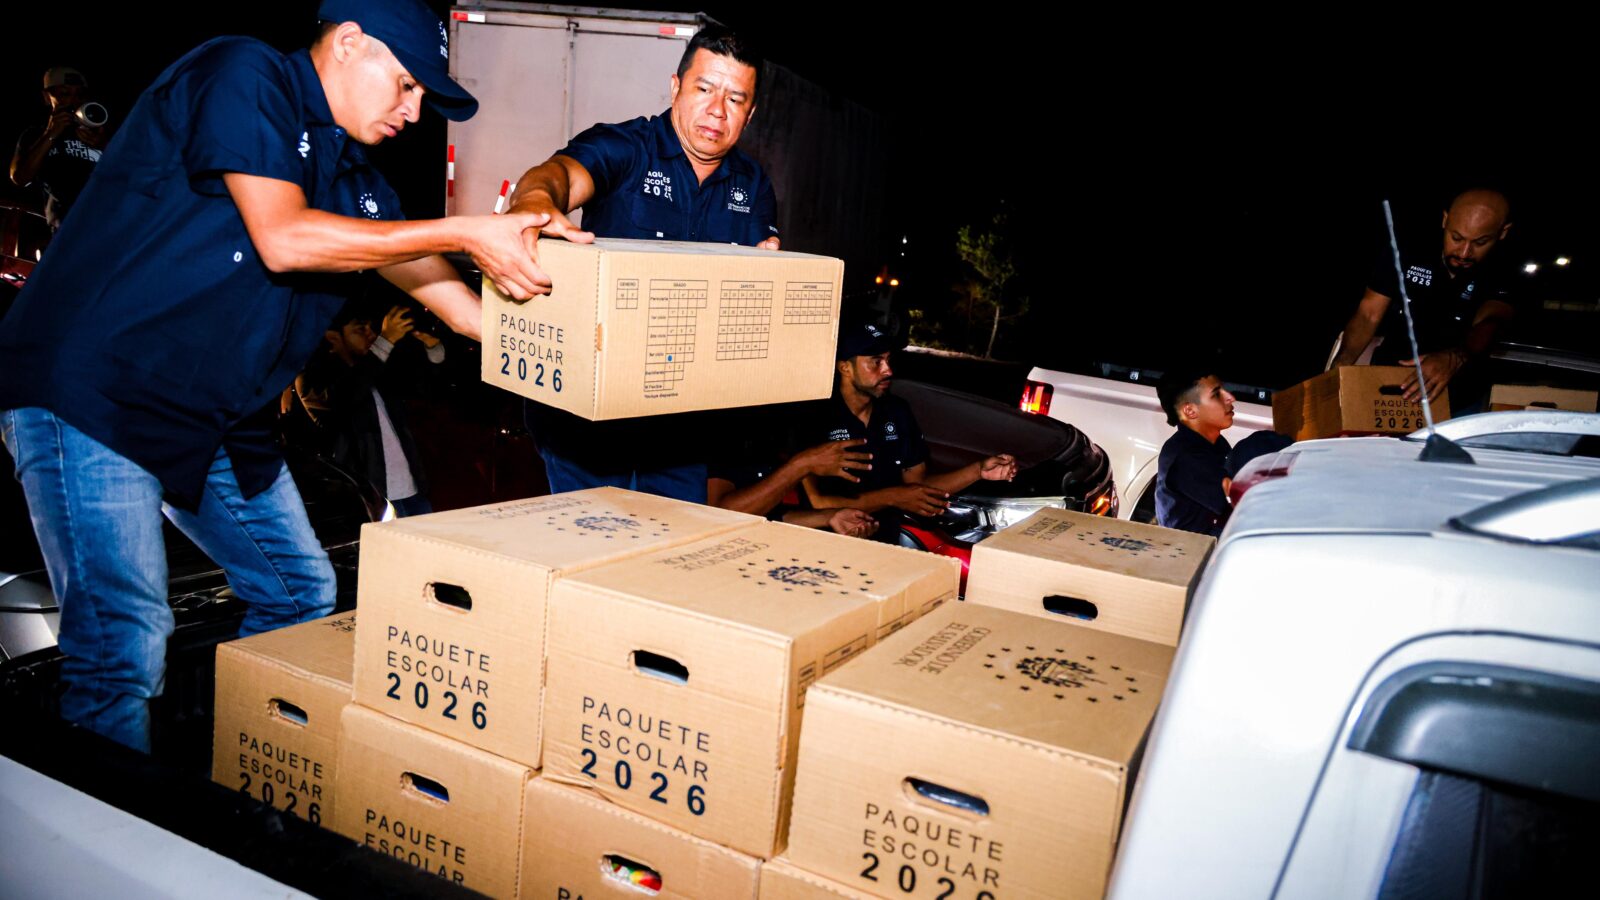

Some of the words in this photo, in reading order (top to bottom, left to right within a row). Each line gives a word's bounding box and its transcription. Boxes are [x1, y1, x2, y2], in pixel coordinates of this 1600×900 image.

[64, 140, 86, 149] THE
[500, 334, 563, 365] ESCOLAR
[501, 313, 563, 343] PAQUETE
[501, 352, 562, 392] 2026
[1374, 400, 1423, 408] PAQUETE
[1374, 409, 1423, 417] ESCOLAR
[1375, 417, 1423, 429] 2026
[388, 625, 490, 673] PAQUETE
[387, 650, 489, 699] ESCOLAR
[387, 672, 487, 730] 2026
[582, 696, 710, 753] PAQUETE
[239, 753, 322, 801] ESCOLAR
[240, 732, 323, 779] PAQUETE
[581, 724, 709, 782] ESCOLAR
[239, 772, 321, 827] 2026
[581, 748, 706, 816] 2026
[366, 808, 466, 866] PAQUETE
[865, 802, 1003, 862] PAQUETE
[863, 829, 1000, 888] ESCOLAR
